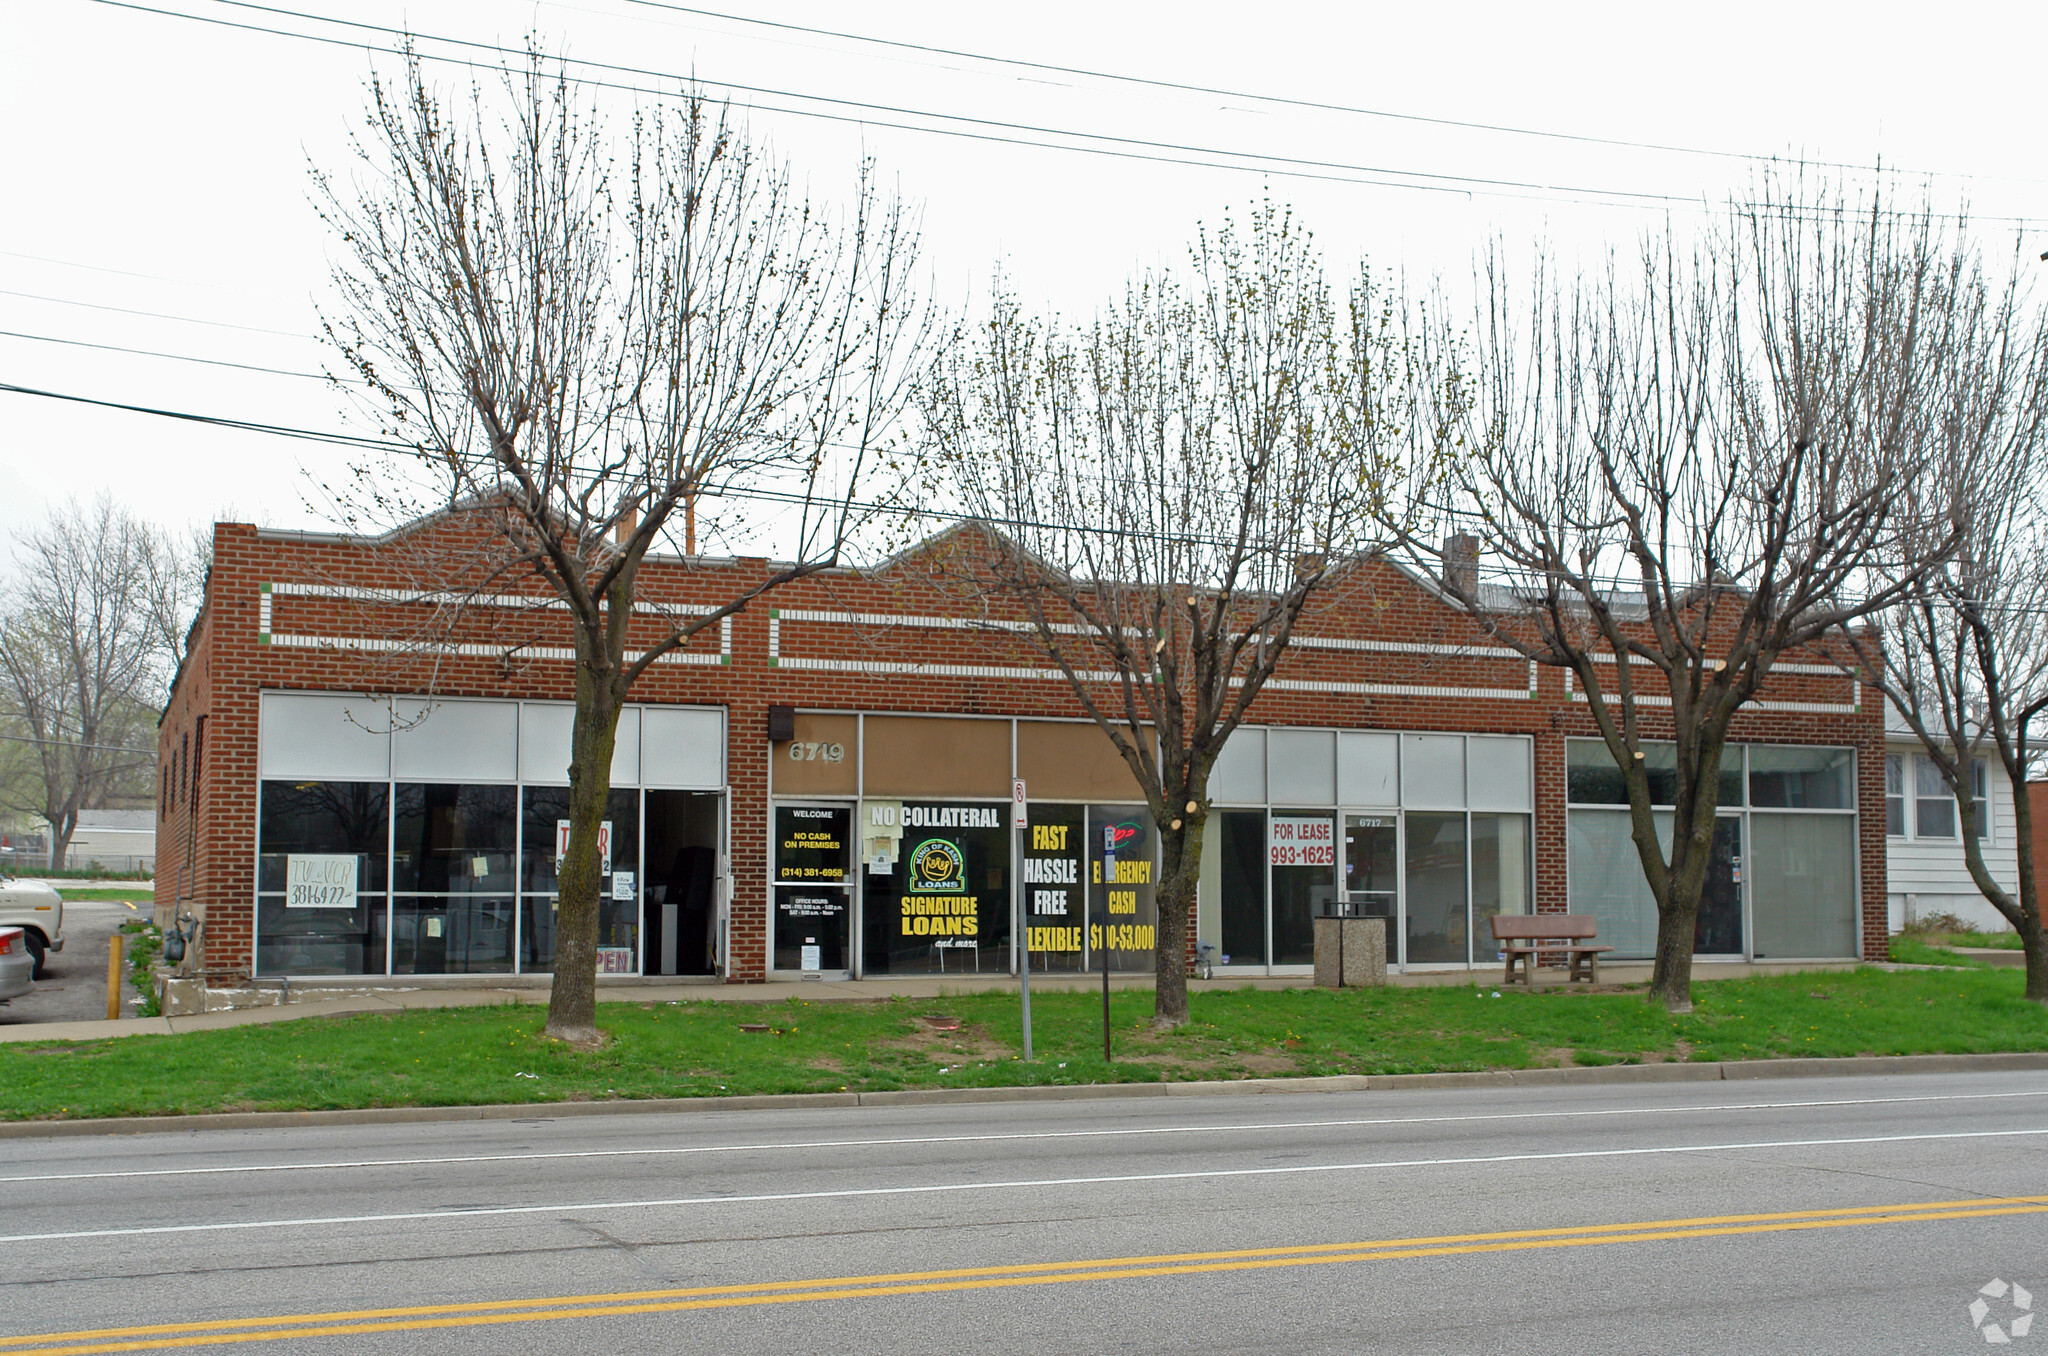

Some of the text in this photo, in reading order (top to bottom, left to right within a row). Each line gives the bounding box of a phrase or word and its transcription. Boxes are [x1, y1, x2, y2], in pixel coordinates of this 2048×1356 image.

[789, 741, 844, 763] 6719
[793, 810, 833, 818] WELCOME
[871, 806, 999, 827] NO COLLATERAL
[1359, 818, 1381, 827] 6717
[794, 832, 831, 840] NO CASH
[1033, 825, 1068, 850] FAST
[1274, 823, 1330, 840] FOR LEASE
[784, 841, 840, 849] ON PREMISES
[915, 846, 931, 865] KING
[943, 845, 960, 865] KASH
[1271, 846, 1334, 864] 993-1625
[781, 868, 843, 877] (314) 381-6958
[1024, 858, 1077, 883] HASSLE
[1093, 861, 1151, 884] ERGENCY
[901, 896, 978, 916] SIGNATURE
[1034, 890, 1067, 915] FREE
[1108, 891, 1136, 914] CASH
[901, 917, 979, 936] LOANS
[935, 936, 978, 948] and more
[1026, 927, 1081, 952] LEXIBLE
[1090, 923, 1154, 952] $10-$3,000
[596, 951, 628, 972] PEN
